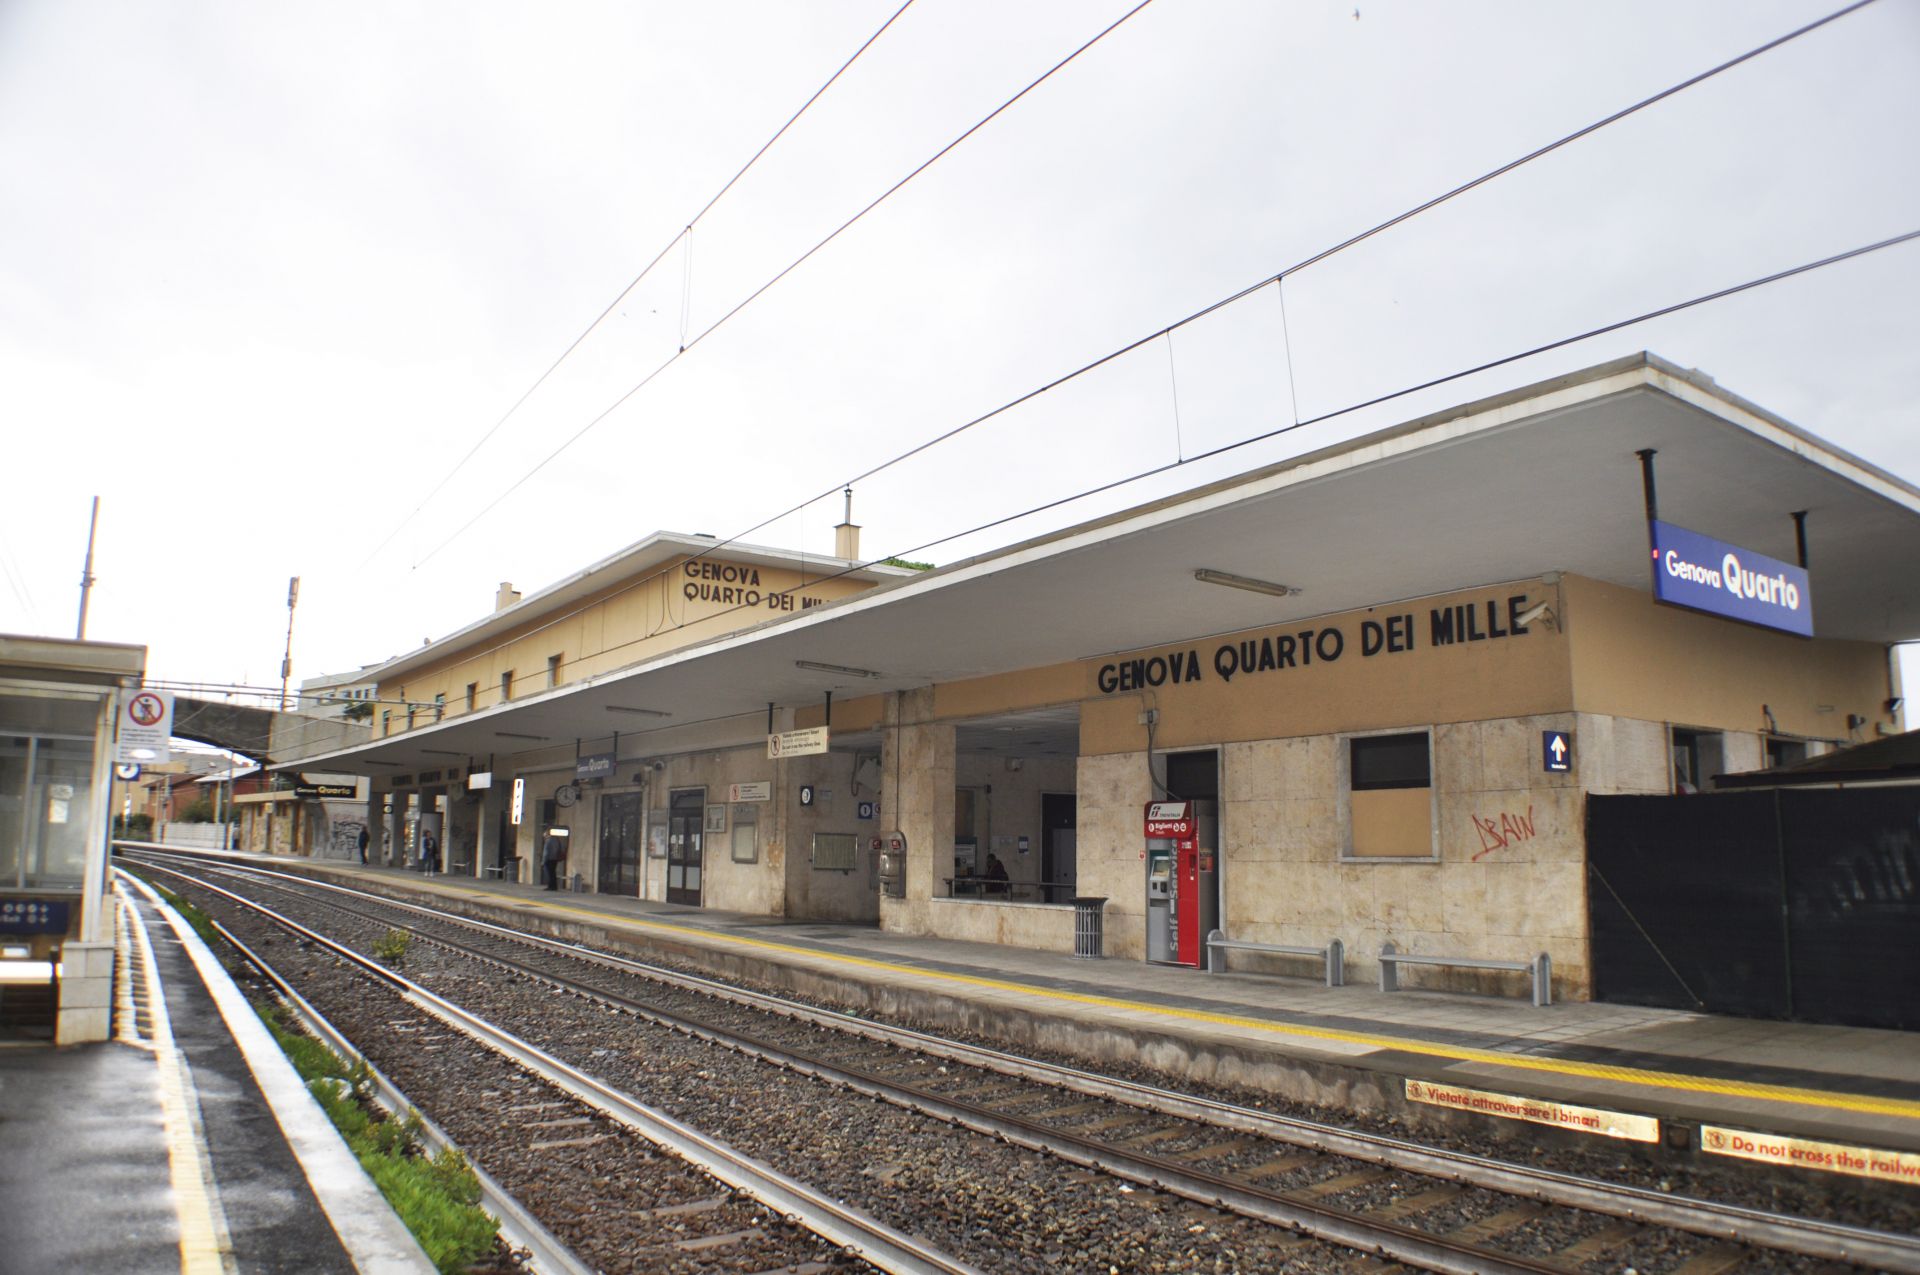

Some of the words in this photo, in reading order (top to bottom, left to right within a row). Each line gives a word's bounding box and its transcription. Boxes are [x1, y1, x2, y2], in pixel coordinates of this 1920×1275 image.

[684, 560, 761, 587] GENOVA
[1665, 550, 1722, 588] Genova
[1722, 553, 1799, 610] Quarto
[684, 582, 761, 607] QUARTO
[768, 592, 794, 612] DEI
[1098, 650, 1202, 694] GENOVA
[1214, 628, 1344, 683] QUARTO
[1360, 614, 1414, 657] DEI
[1430, 595, 1529, 647] MILLE
[1169, 839, 1179, 899] Service
[1169, 917, 1179, 951] Self
[1472, 1098, 1550, 1119] attraversare
[1559, 1110, 1600, 1128] binari
[1732, 1136, 1755, 1153] Do
[1759, 1144, 1786, 1157] not
[1837, 1151, 1867, 1169] the
